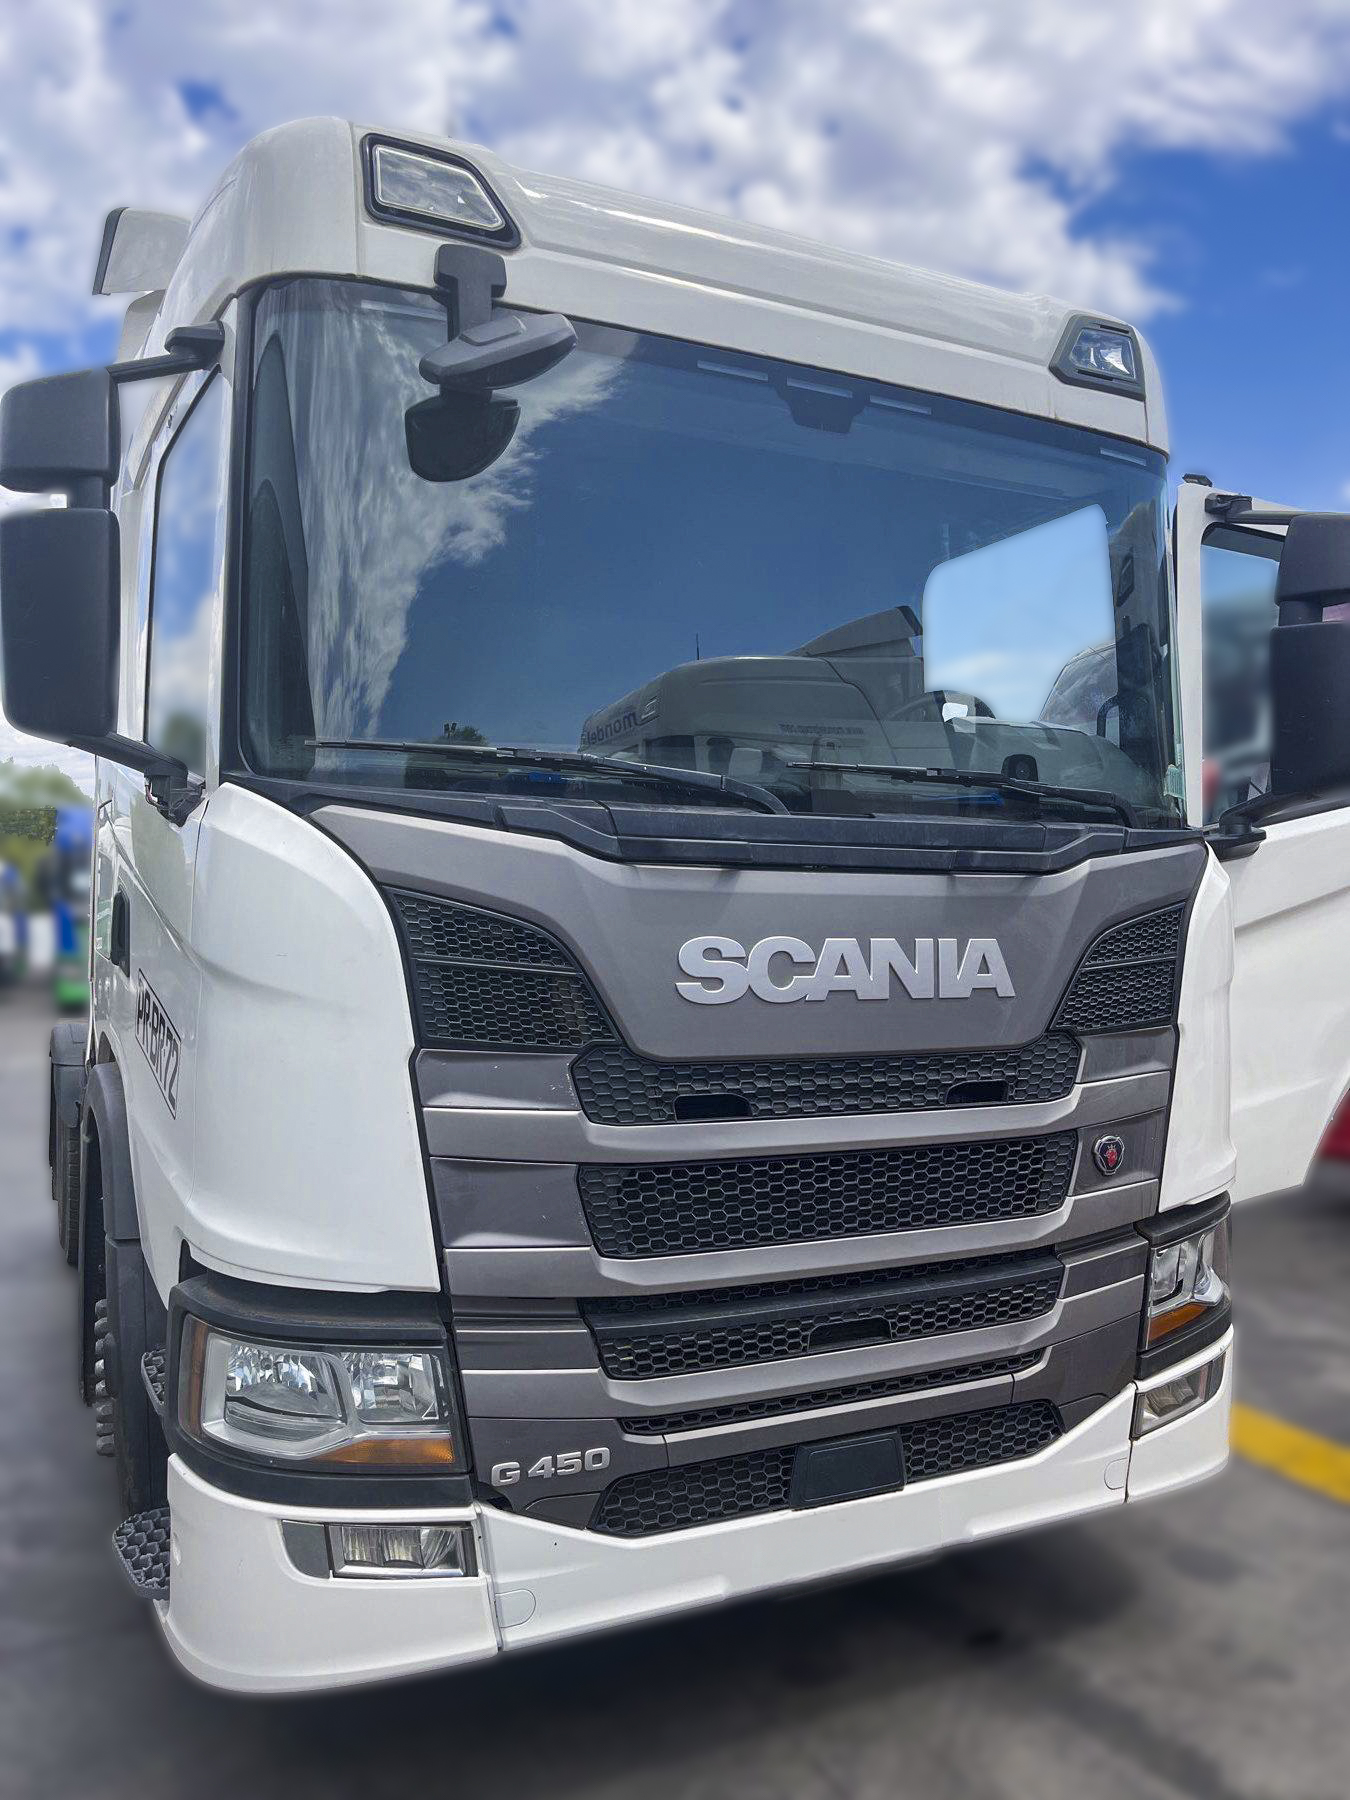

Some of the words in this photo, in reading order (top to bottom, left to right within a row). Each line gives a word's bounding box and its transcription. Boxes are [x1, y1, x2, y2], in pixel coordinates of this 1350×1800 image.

[675, 935, 1016, 1005] SCANIA
[491, 1461, 521, 1487] G
[528, 1447, 611, 1479] 450
